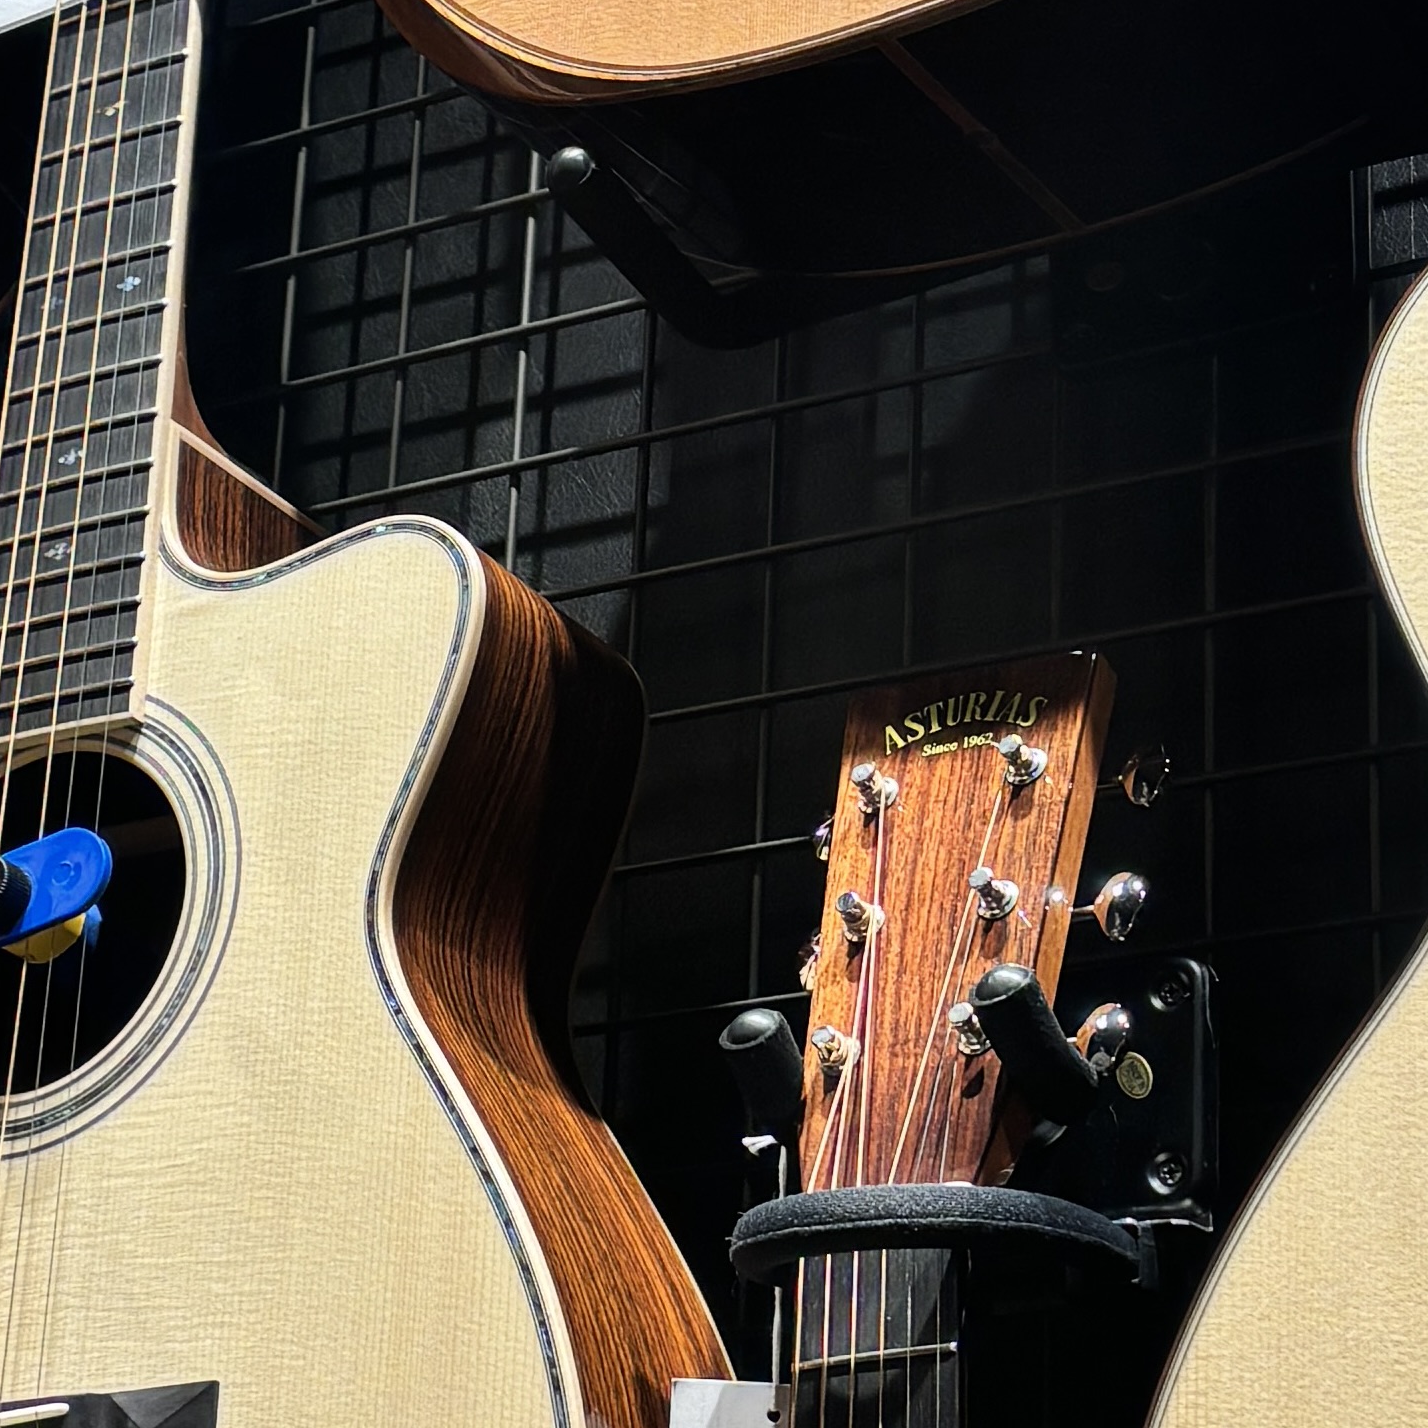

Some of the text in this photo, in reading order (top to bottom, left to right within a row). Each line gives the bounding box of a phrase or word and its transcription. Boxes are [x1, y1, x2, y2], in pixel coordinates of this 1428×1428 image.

[884, 690, 1048, 755] ASTURIAS
[922, 732, 994, 758] Since 1962
